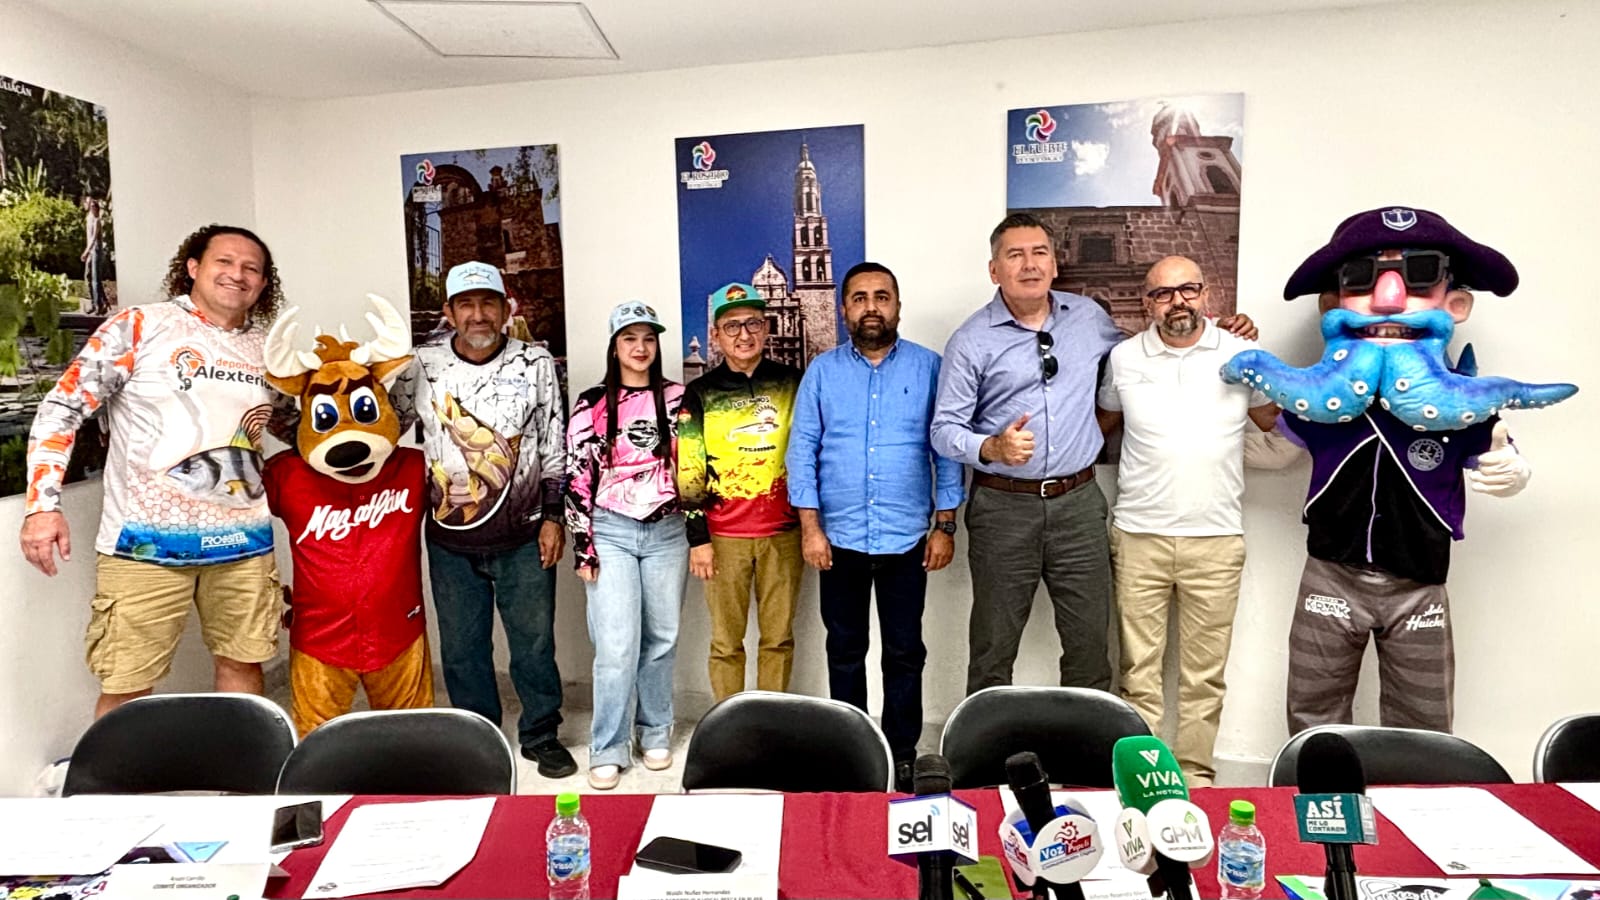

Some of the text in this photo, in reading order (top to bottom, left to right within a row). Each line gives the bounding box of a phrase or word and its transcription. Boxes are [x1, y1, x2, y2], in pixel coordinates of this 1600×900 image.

[216, 358, 259, 373] deportes
[296, 489, 413, 545] Mazatlán
[1136, 770, 1183, 788] VIVA
[1306, 795, 1344, 818] ASÍ
[898, 814, 932, 845] sel
[952, 821, 970, 850] sel
[1160, 825, 1204, 843] GPM
[1041, 845, 1066, 859] Voz
[1122, 836, 1145, 857] VIVA
